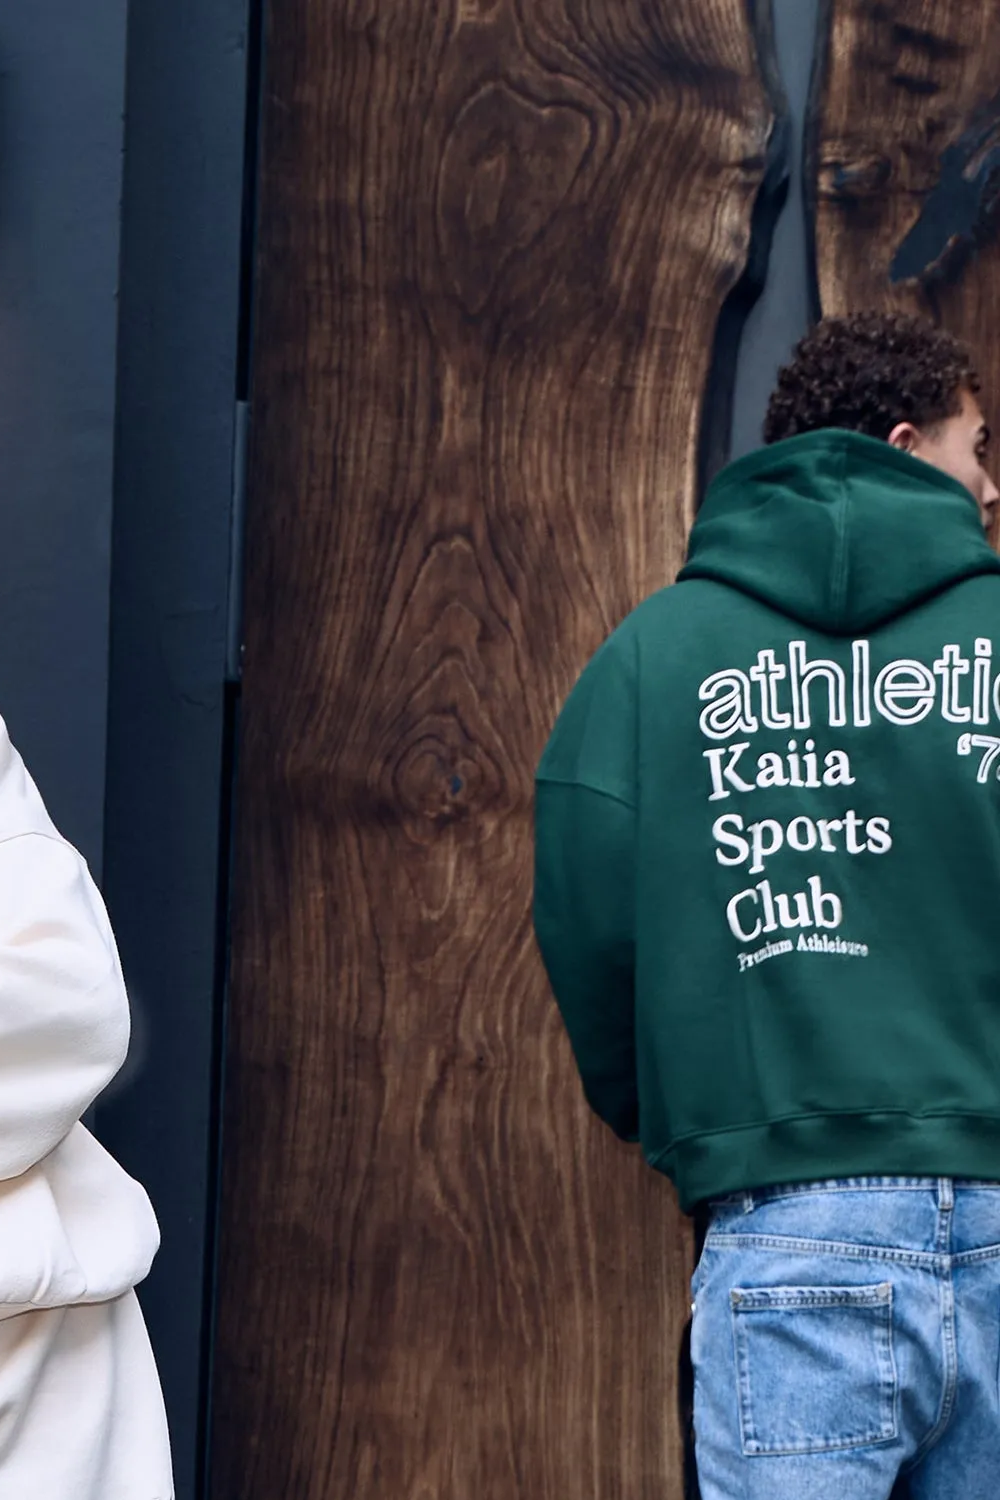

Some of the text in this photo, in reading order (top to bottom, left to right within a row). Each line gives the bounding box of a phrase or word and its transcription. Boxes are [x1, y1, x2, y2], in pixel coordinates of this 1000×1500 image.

[698, 637, 1000, 740] athleti
[702, 738, 856, 801] Kaiia
[712, 809, 893, 874] Sports
[726, 875, 843, 942] Club
[737, 932, 870, 972] Premium Athleisure
